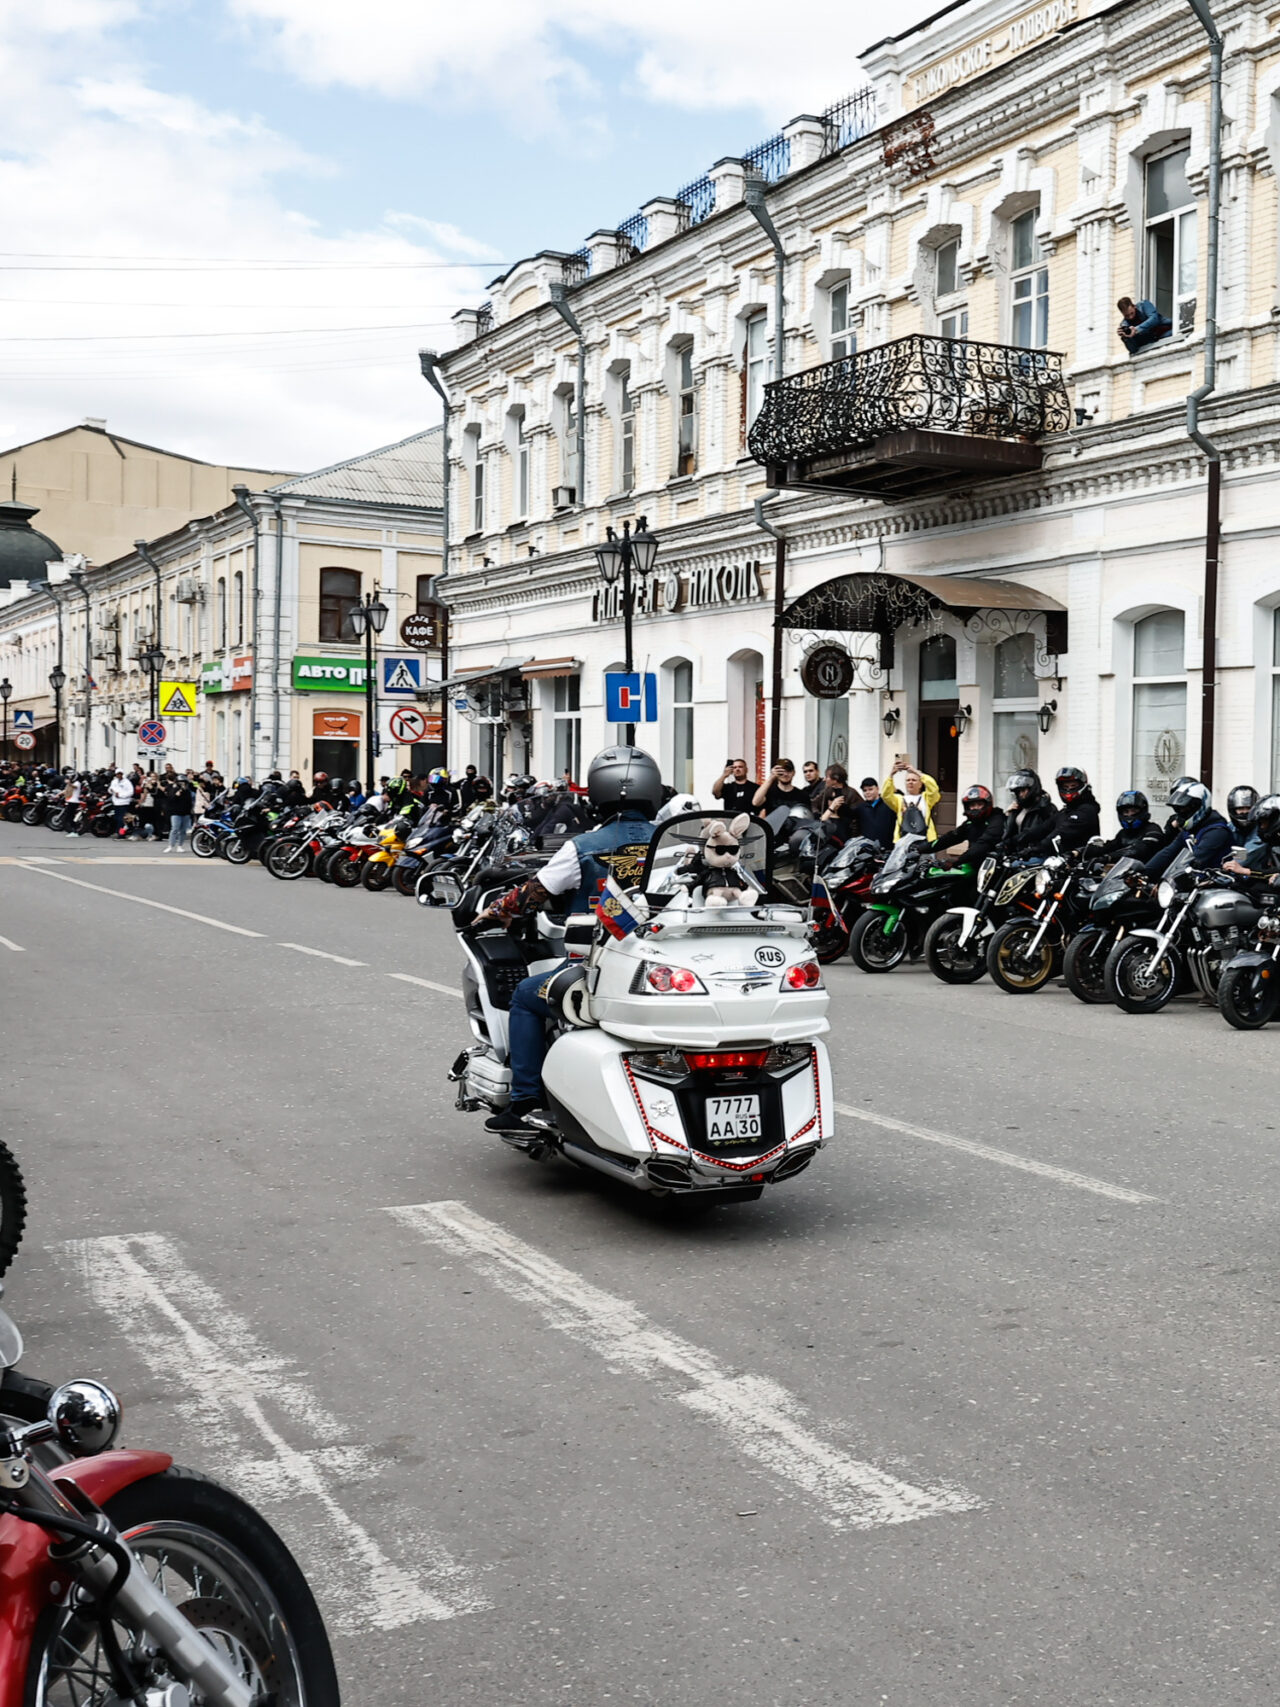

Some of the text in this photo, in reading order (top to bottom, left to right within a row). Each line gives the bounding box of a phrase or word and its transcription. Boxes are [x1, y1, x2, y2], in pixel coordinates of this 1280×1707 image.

[688, 560, 765, 607] НИКОЛЬ
[405, 626, 434, 636] КАФЕ
[298, 664, 347, 679] АВТО
[758, 951, 782, 962] RUS
[712, 1097, 753, 1115] 7777
[739, 1119, 759, 1134] 30
